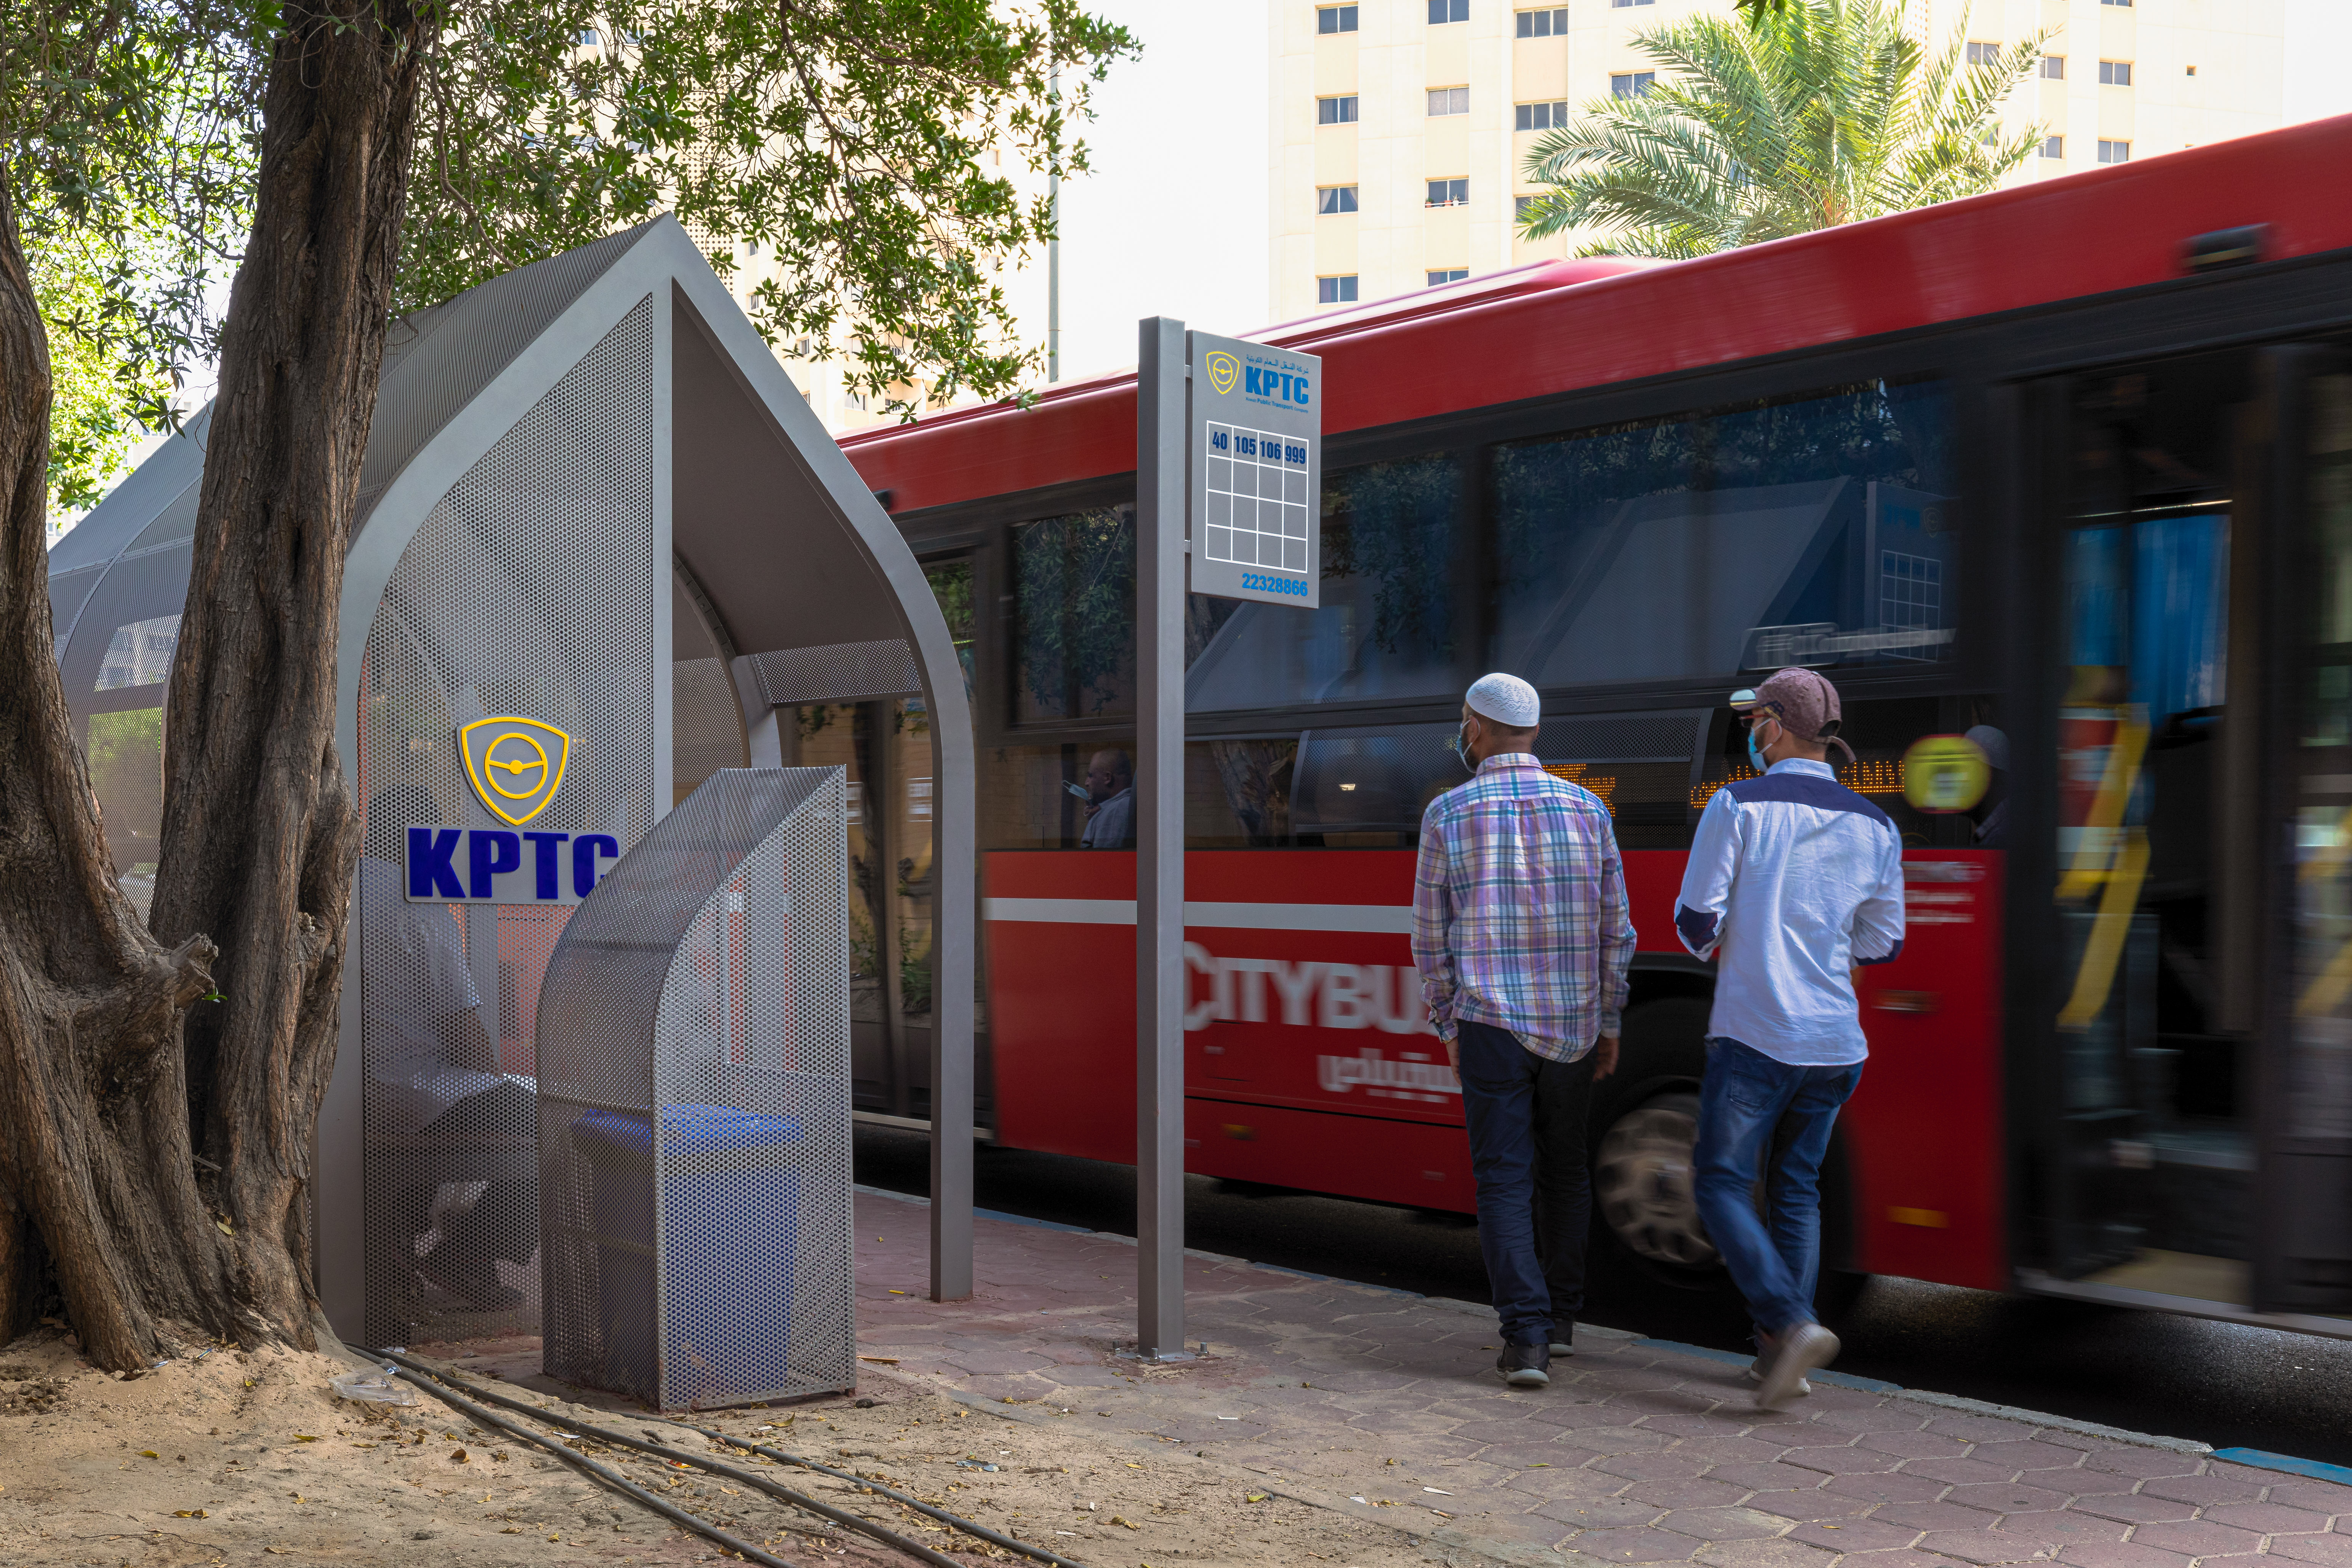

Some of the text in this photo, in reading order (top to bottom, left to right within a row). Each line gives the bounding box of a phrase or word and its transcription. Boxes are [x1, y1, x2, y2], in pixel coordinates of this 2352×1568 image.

[1246, 354, 1309, 375] شركة النقل العام الكويتية
[1246, 365, 1309, 404] KPTC
[1272, 401, 1293, 410] Transport
[1212, 431, 1306, 464] 40 105 106 999
[1242, 573, 1308, 596] 22328866
[408, 828, 618, 899] KPTC
[1184, 941, 1440, 1037] CITYBU
